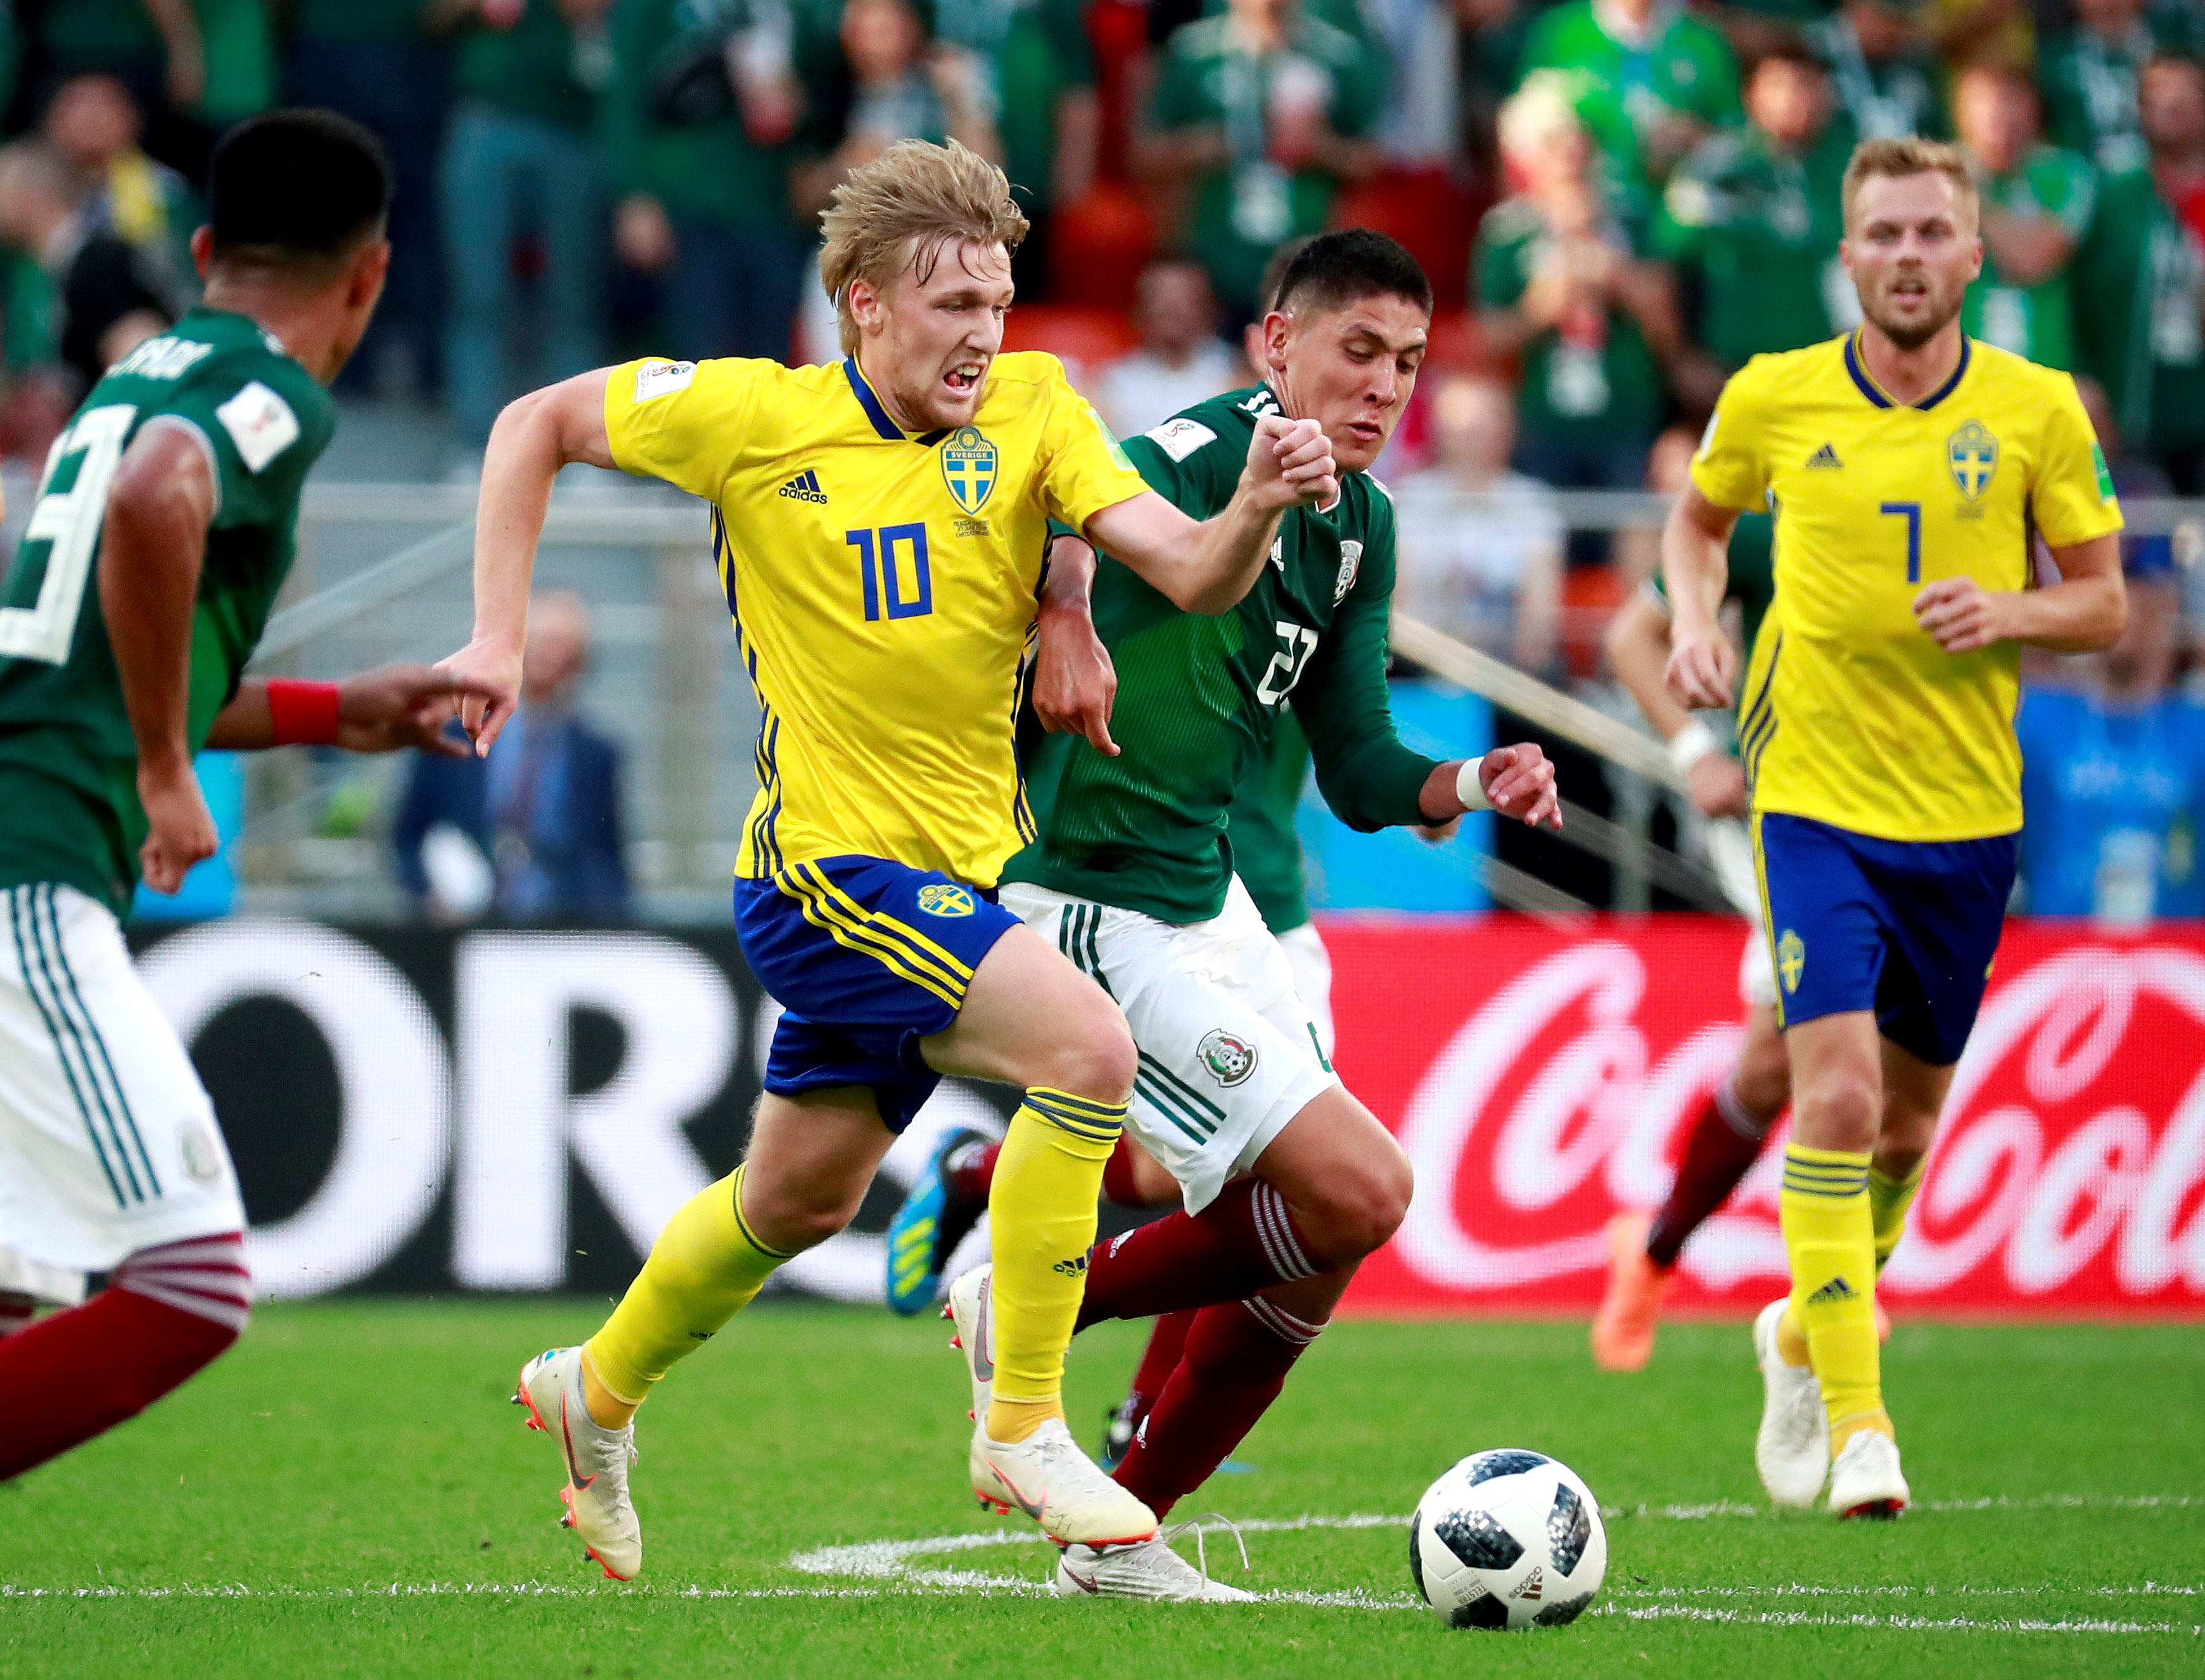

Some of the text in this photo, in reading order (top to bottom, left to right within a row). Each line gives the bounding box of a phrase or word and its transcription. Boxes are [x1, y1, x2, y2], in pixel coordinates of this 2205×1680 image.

[779, 487, 828, 504] adidas
[846, 522, 933, 621] 10
[1881, 504, 1921, 582] 7
